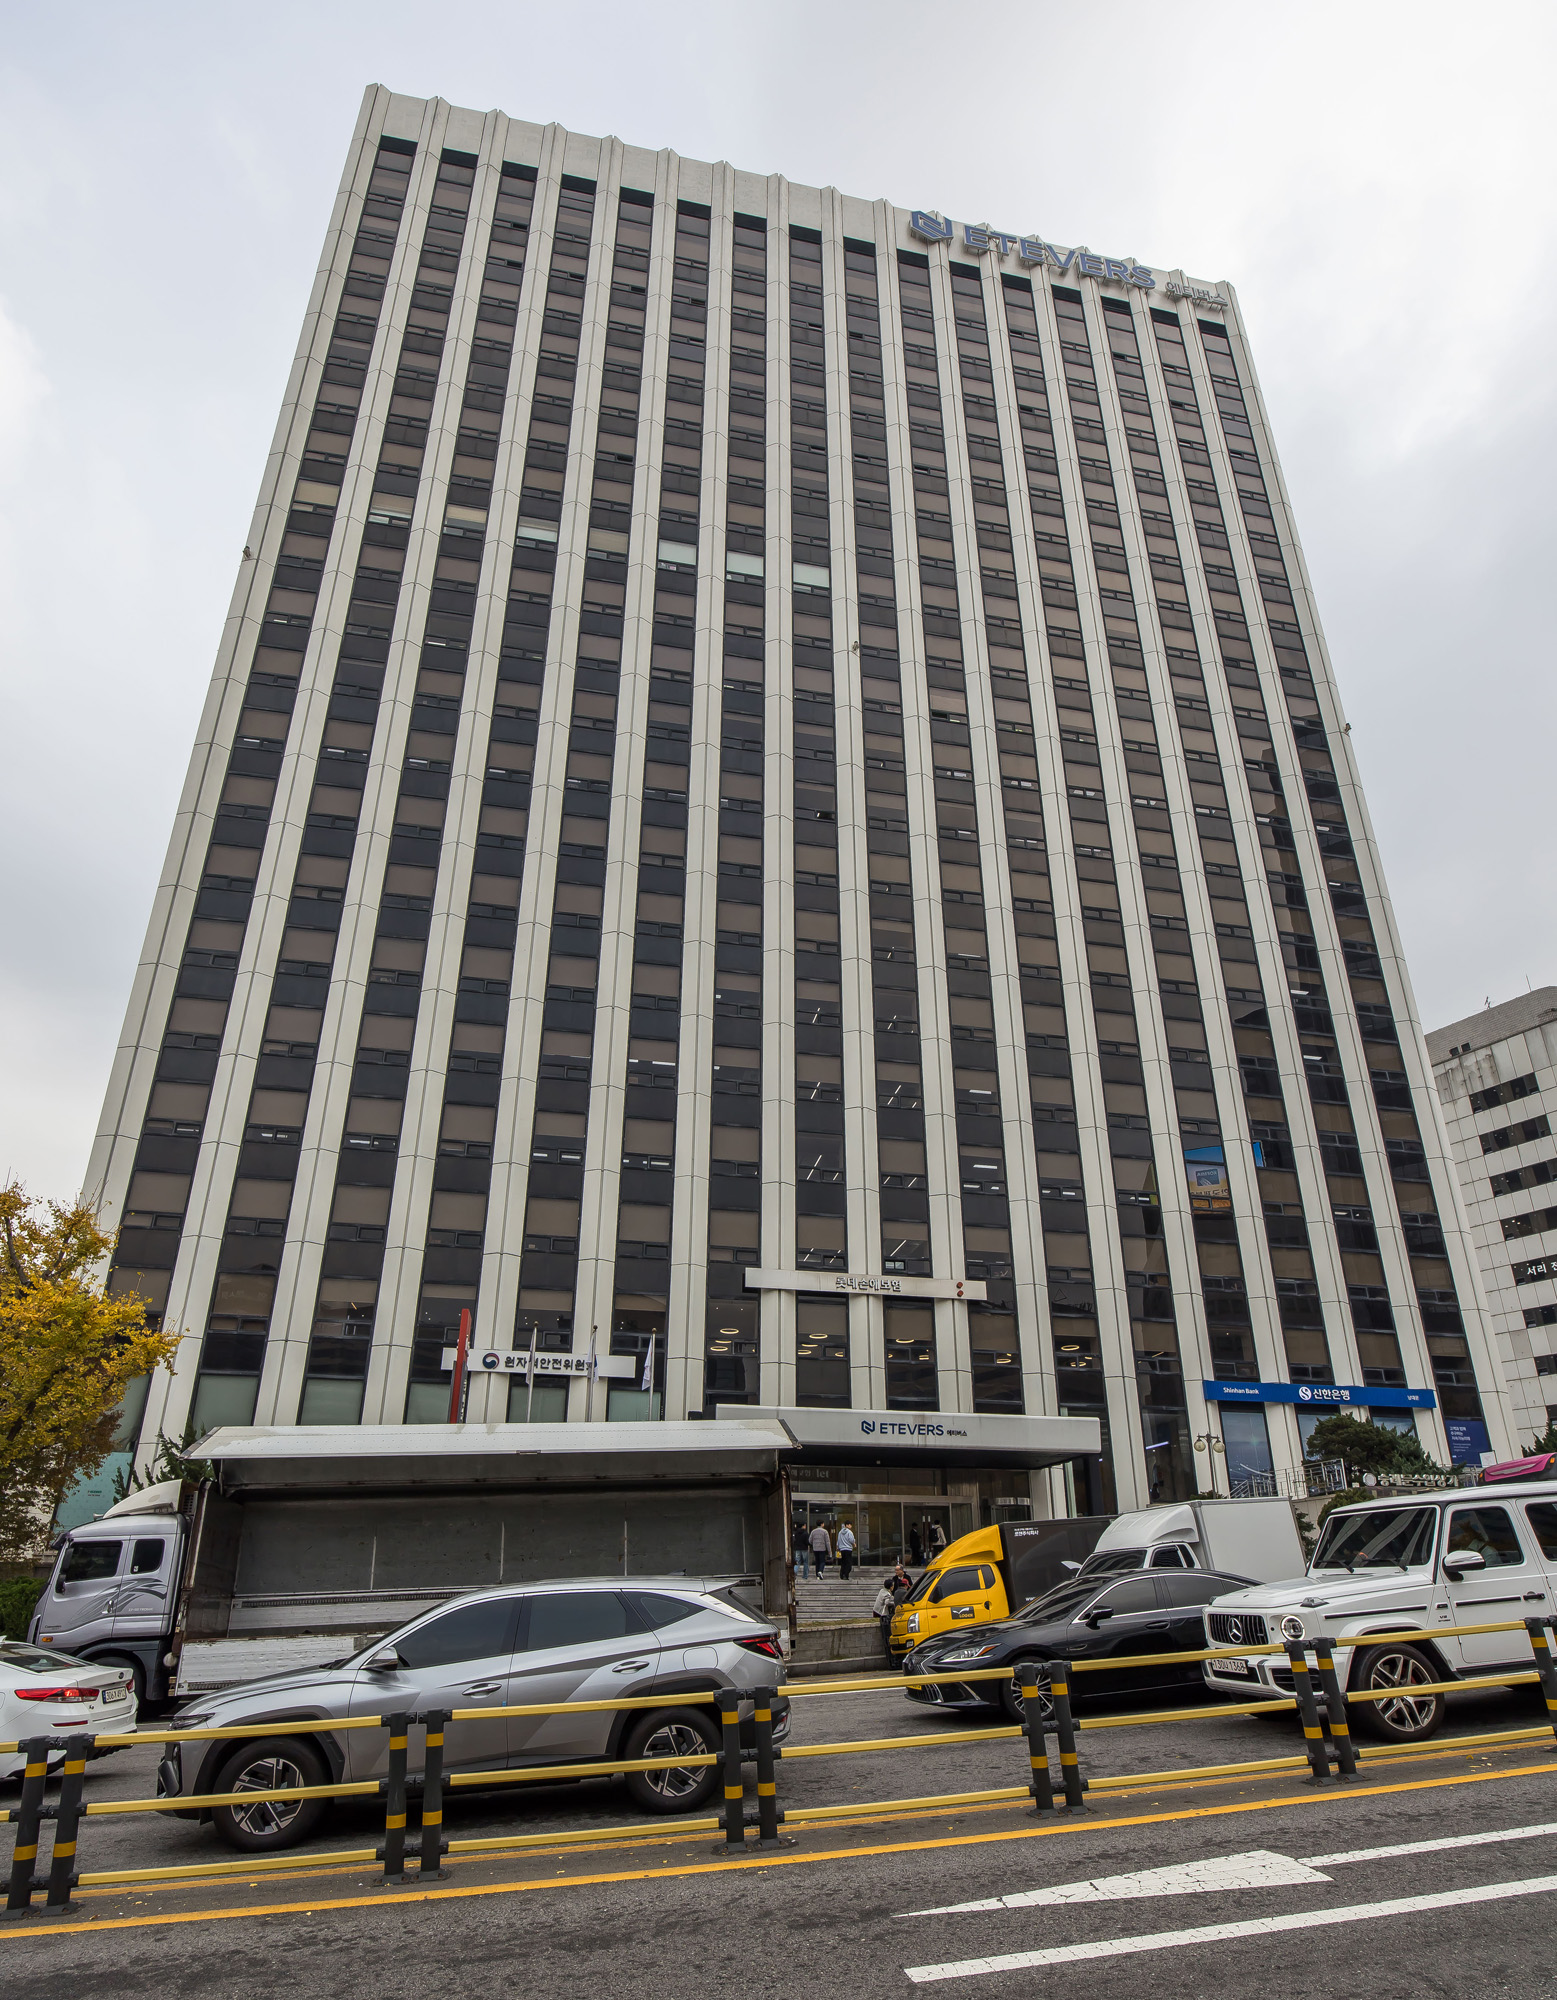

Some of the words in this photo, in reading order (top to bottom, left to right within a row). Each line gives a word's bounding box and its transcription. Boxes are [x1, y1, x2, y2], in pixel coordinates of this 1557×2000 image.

[964, 224, 1156, 289] ETEVERS
[1313, 1388, 1351, 1400] 신한은행
[880, 1422, 944, 1436] ETEVERS
